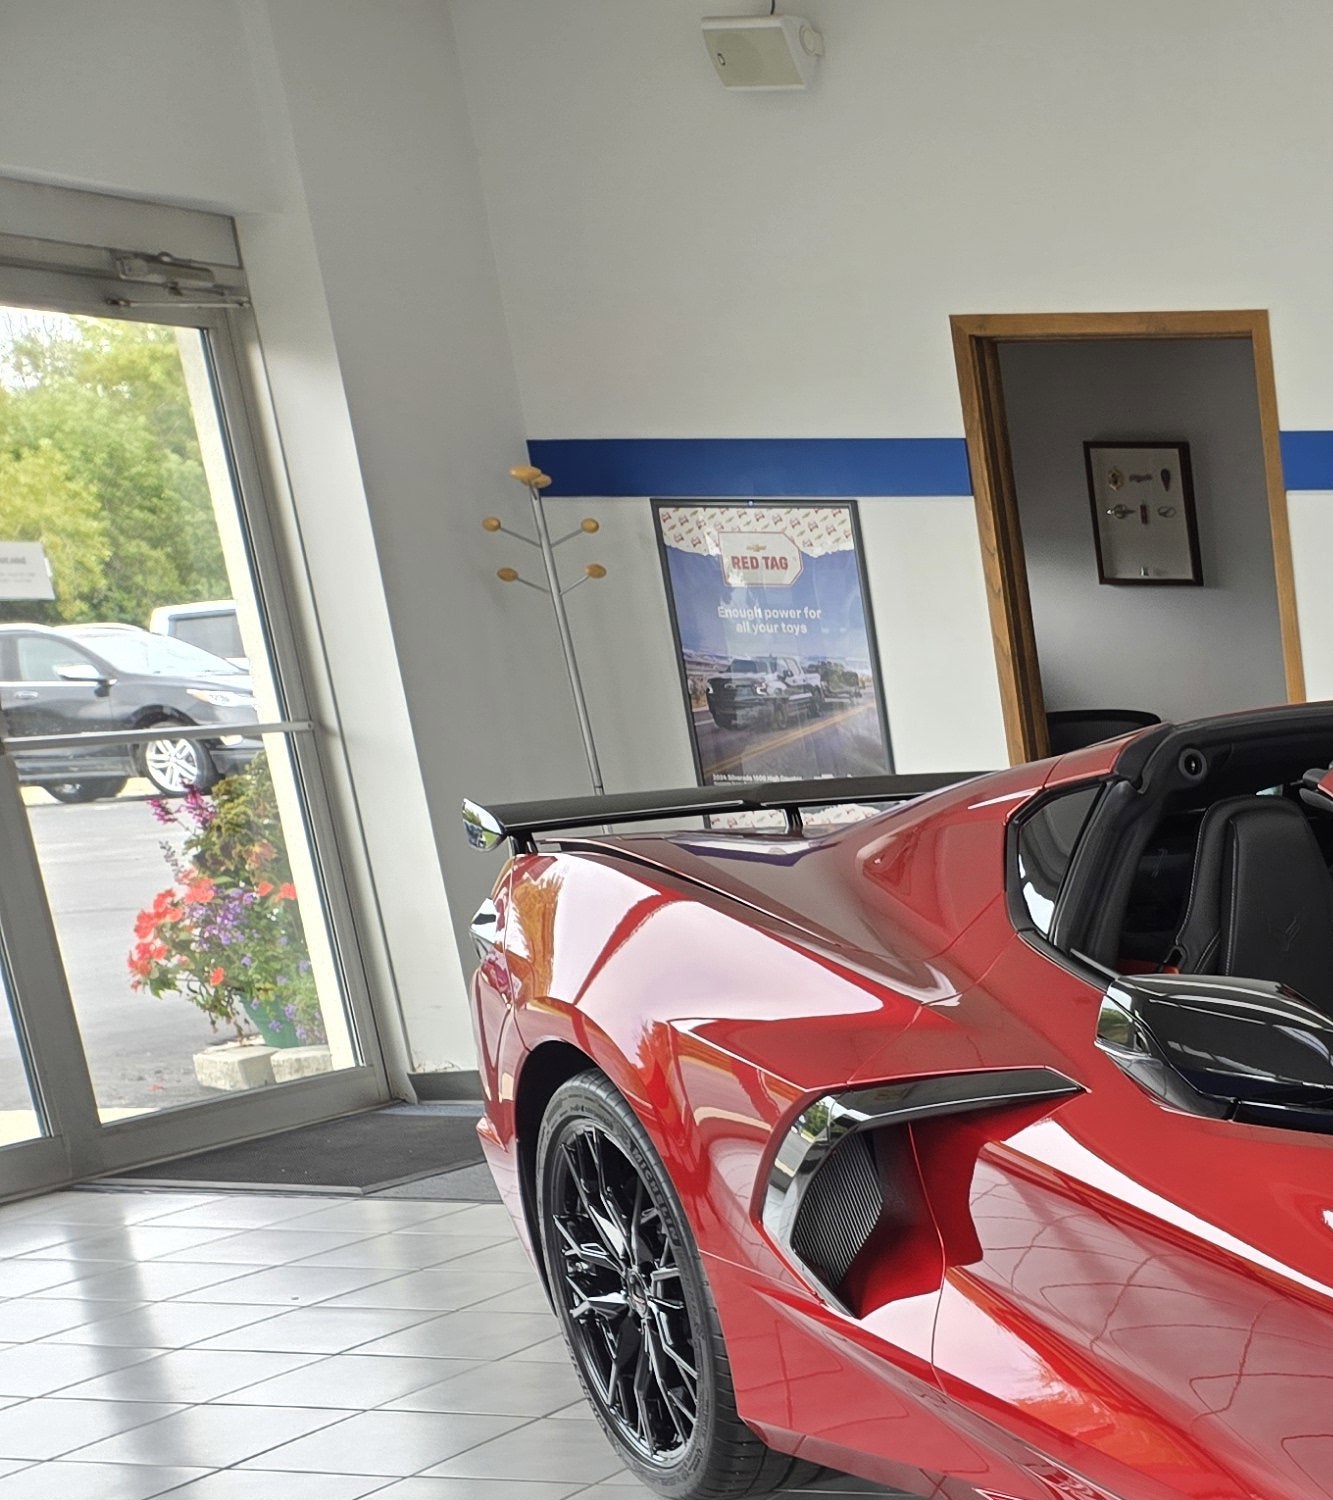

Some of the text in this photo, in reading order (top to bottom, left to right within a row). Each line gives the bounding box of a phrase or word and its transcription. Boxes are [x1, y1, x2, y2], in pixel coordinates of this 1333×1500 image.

[731, 555, 788, 570] RED TAG
[718, 605, 822, 621] Enough power for
[736, 622, 807, 635] all your toys
[632, 1147, 678, 1240] MICHELIN
